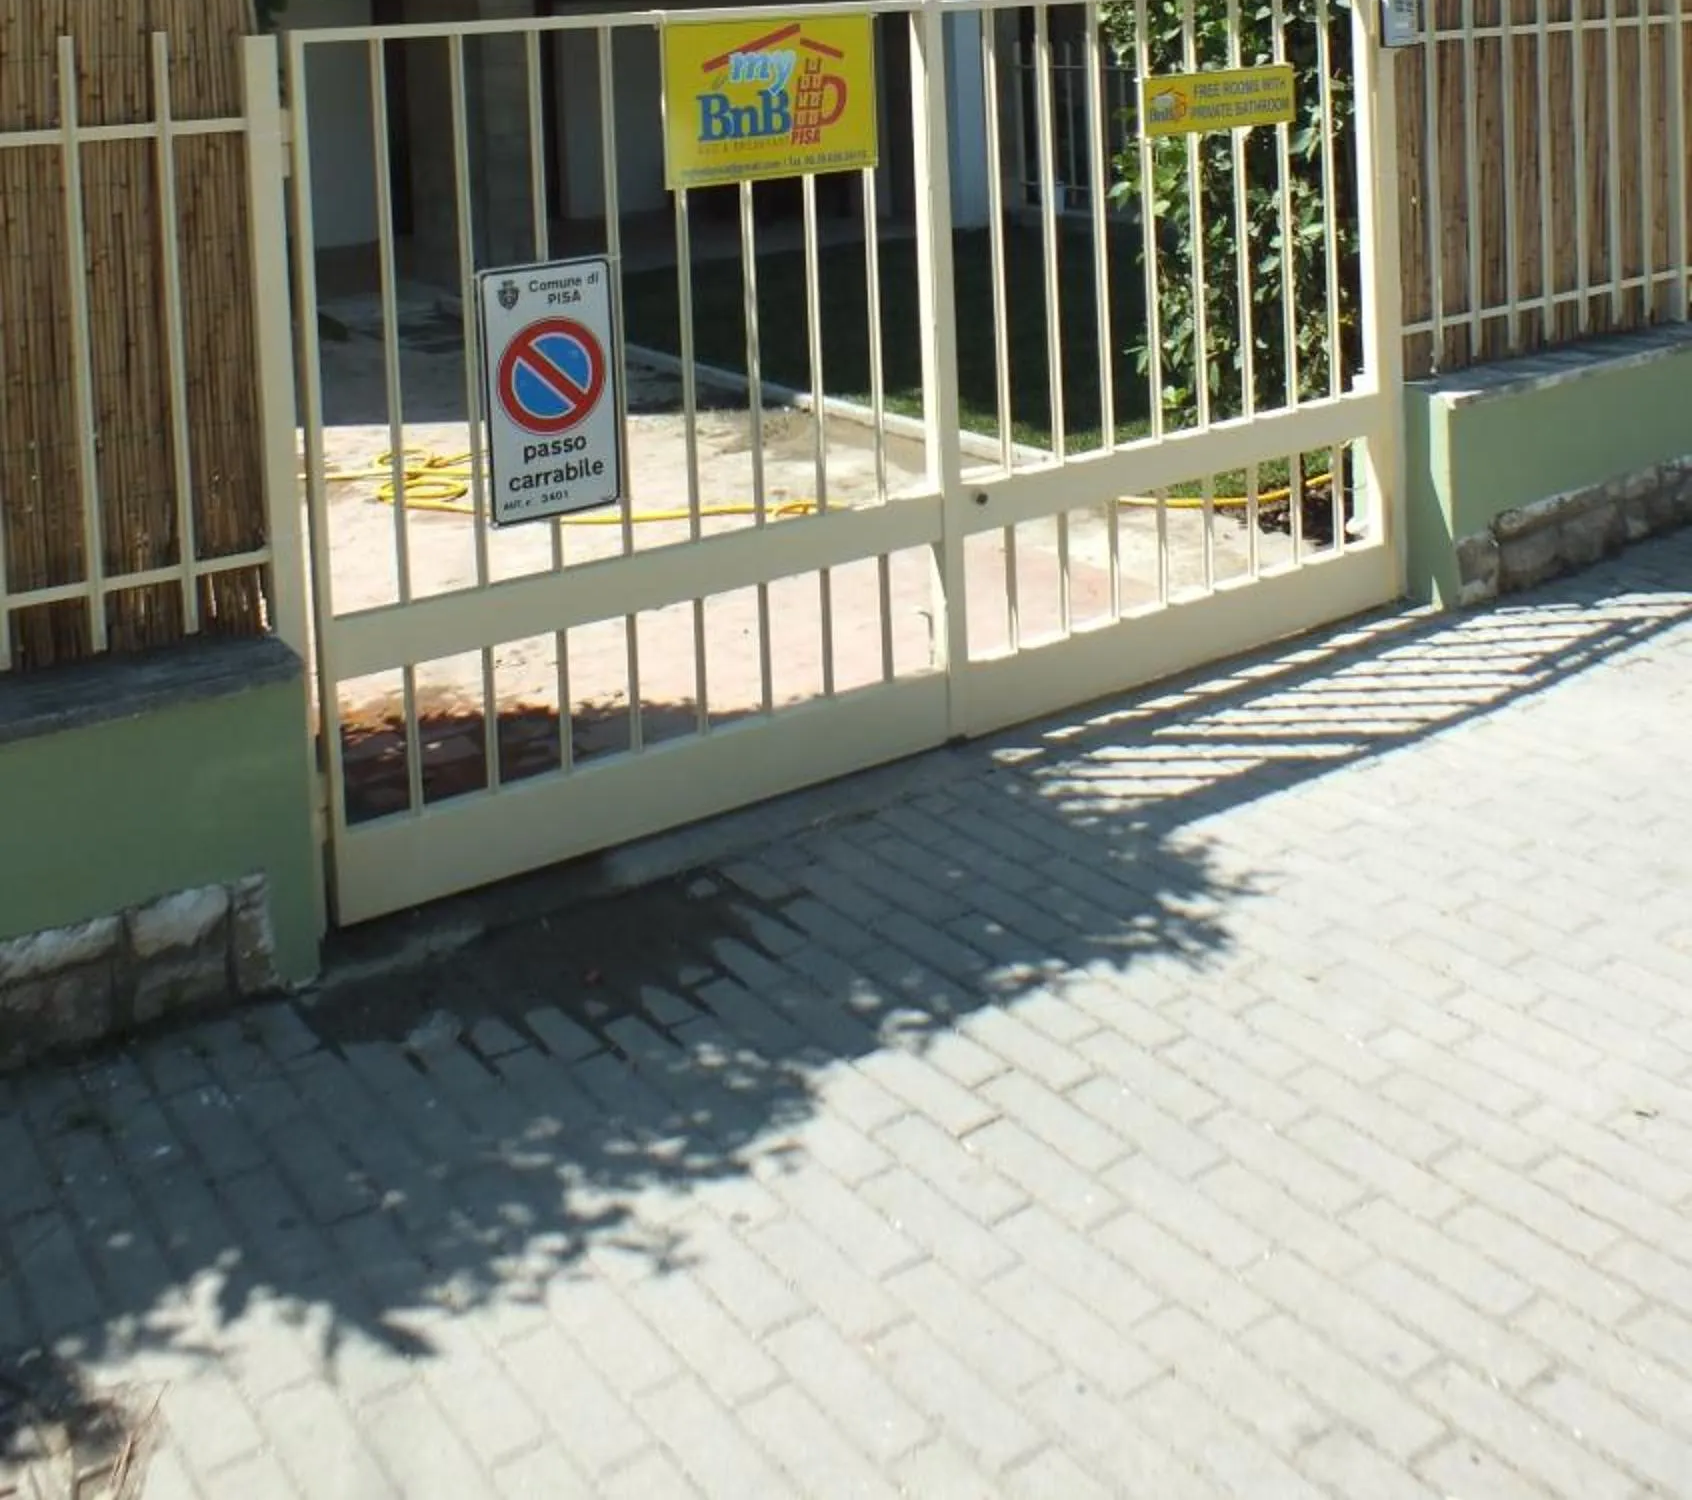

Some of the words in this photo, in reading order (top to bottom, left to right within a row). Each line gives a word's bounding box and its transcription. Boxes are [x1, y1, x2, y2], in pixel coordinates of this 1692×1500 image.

[728, 49, 797, 95] my
[1193, 83, 1220, 98] FREE
[1222, 79, 1260, 96] ROOMS
[1261, 76, 1286, 92] WITH
[696, 88, 793, 142] BnB
[1187, 101, 1233, 120] PRIVATE
[1234, 97, 1289, 117] BATHROOM
[790, 128, 821, 146] PISA
[528, 274, 582, 292] Comune
[586, 272, 599, 285] di
[547, 289, 583, 305] PISA
[523, 435, 588, 464] passo
[508, 457, 605, 491] carrabile
